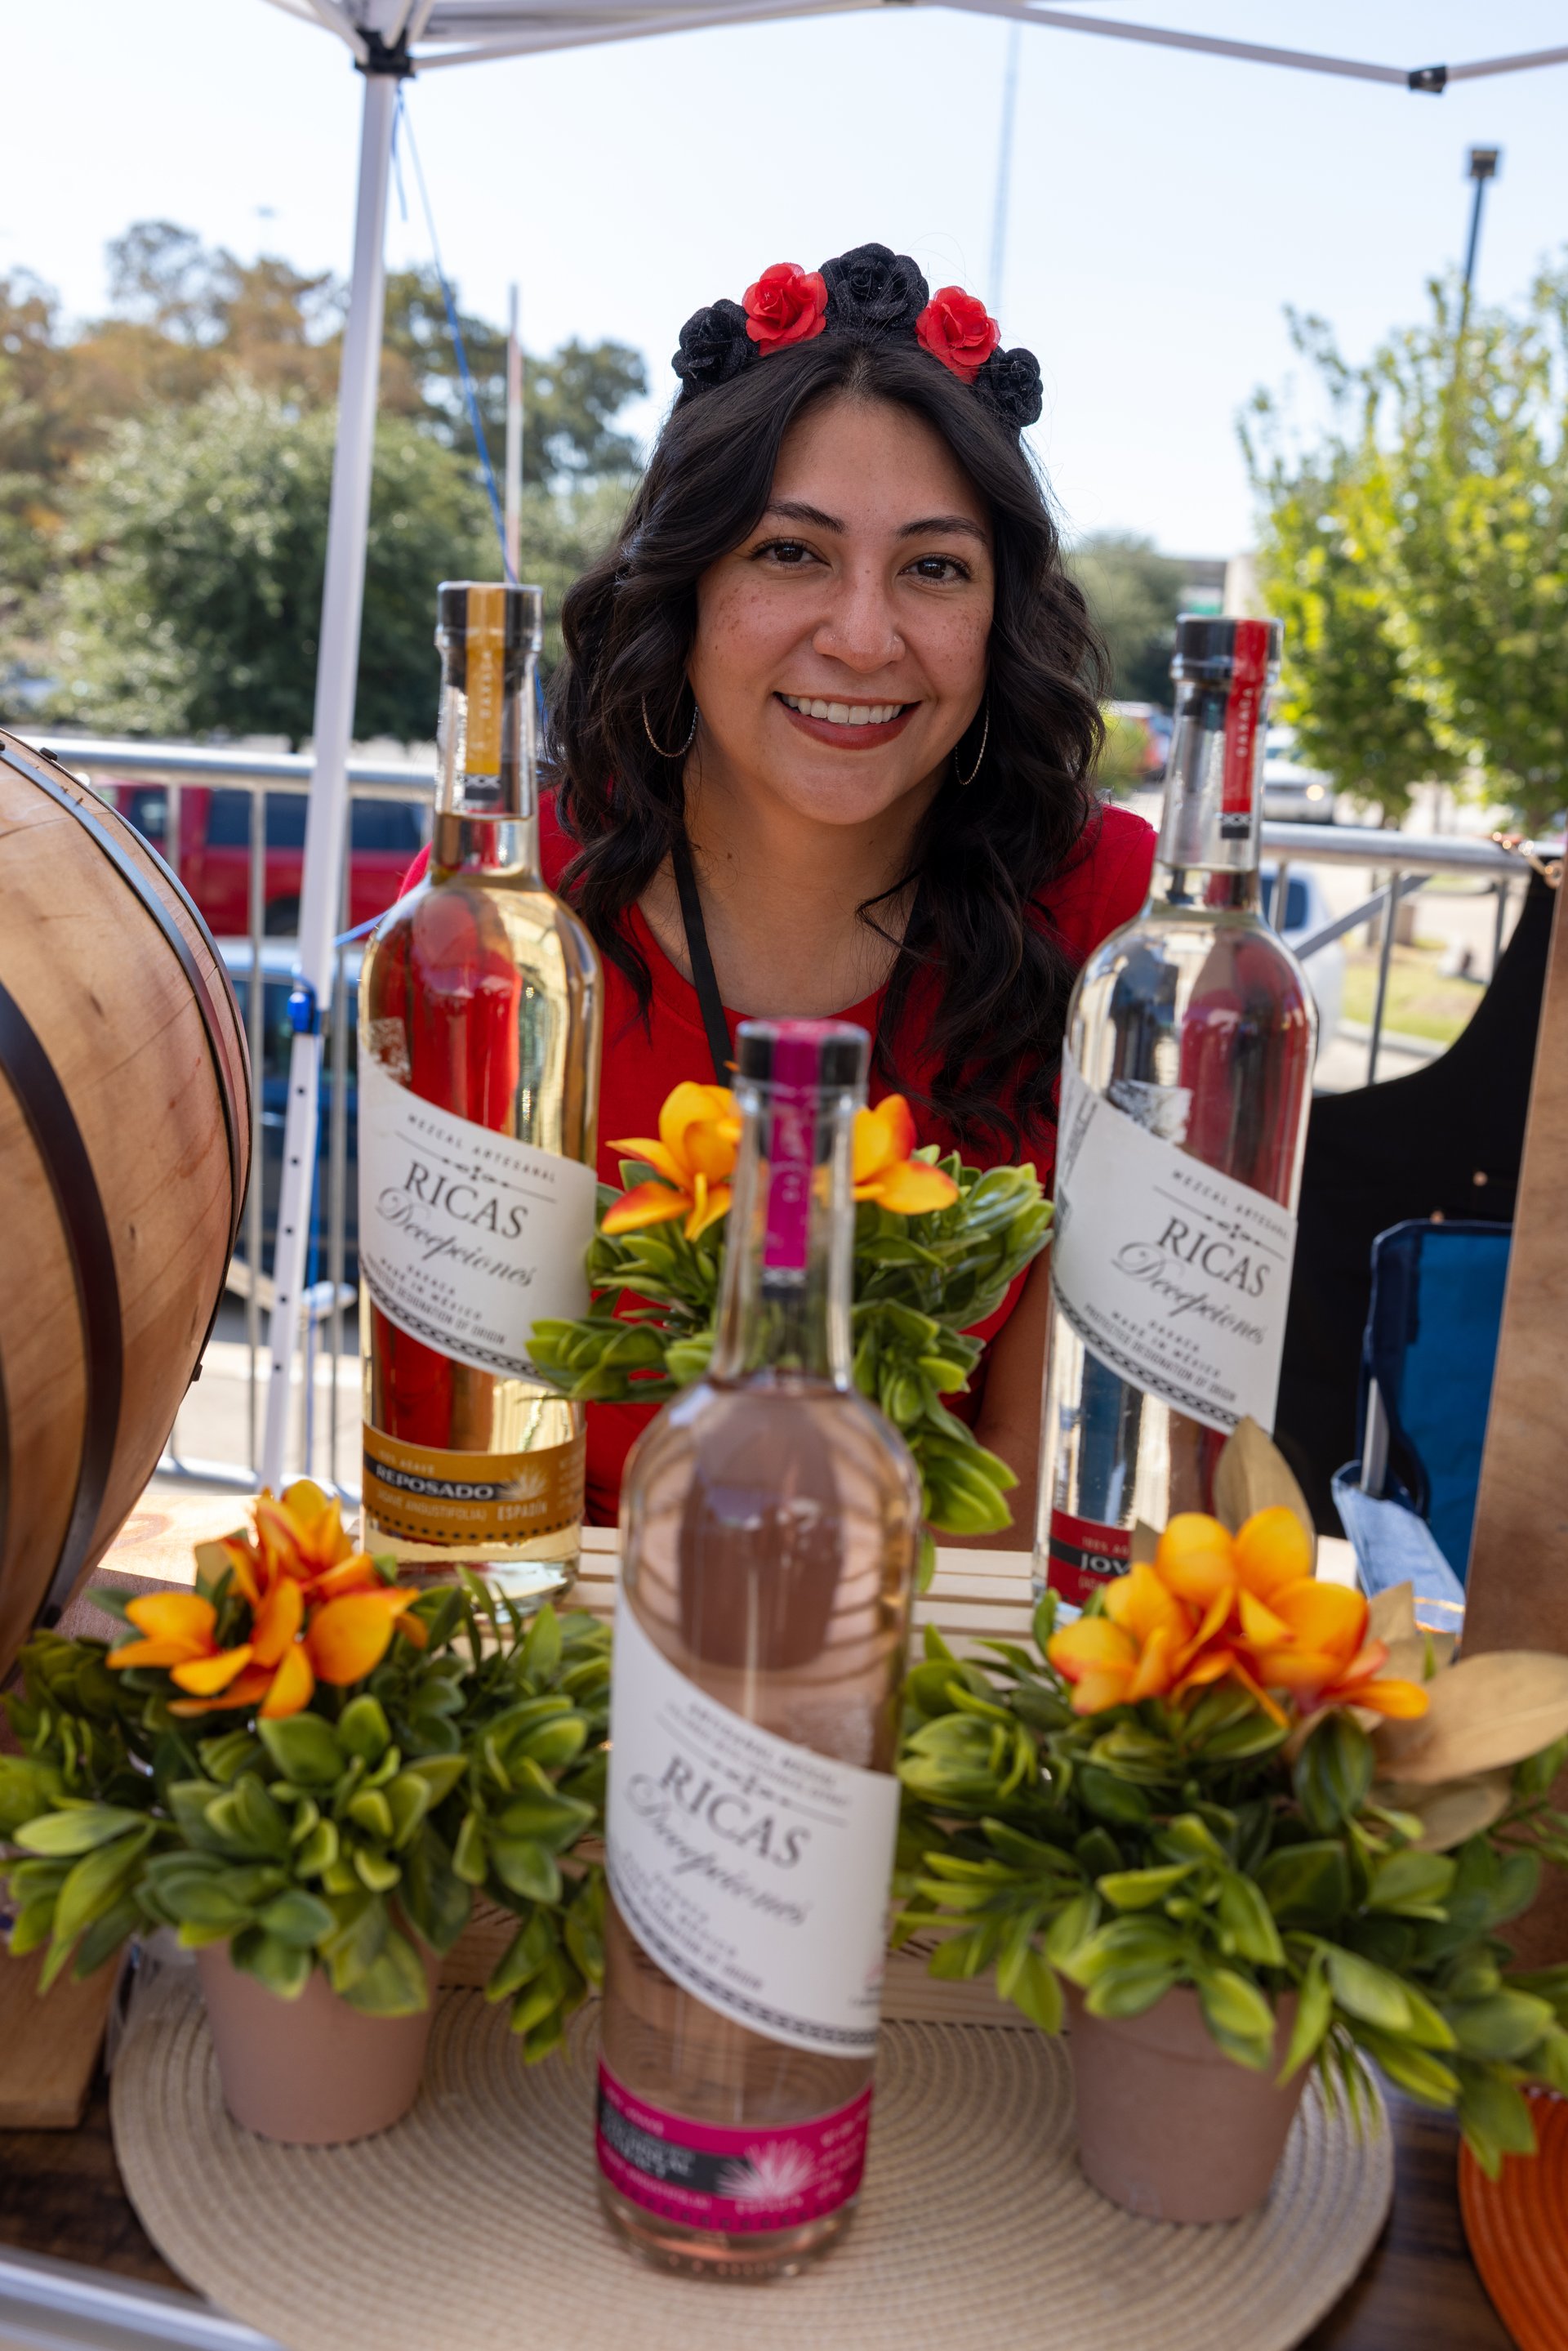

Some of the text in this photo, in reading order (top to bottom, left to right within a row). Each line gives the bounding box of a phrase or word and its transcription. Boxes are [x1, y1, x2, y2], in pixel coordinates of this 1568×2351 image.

[408, 1113, 462, 1149] MEZCAL
[403, 1160, 528, 1239] RICAS
[1157, 1216, 1271, 1298] RICAS
[376, 1463, 495, 1501] REPOSADO
[1080, 1552, 1131, 1576] JOV
[659, 1755, 812, 1869] RICAS
